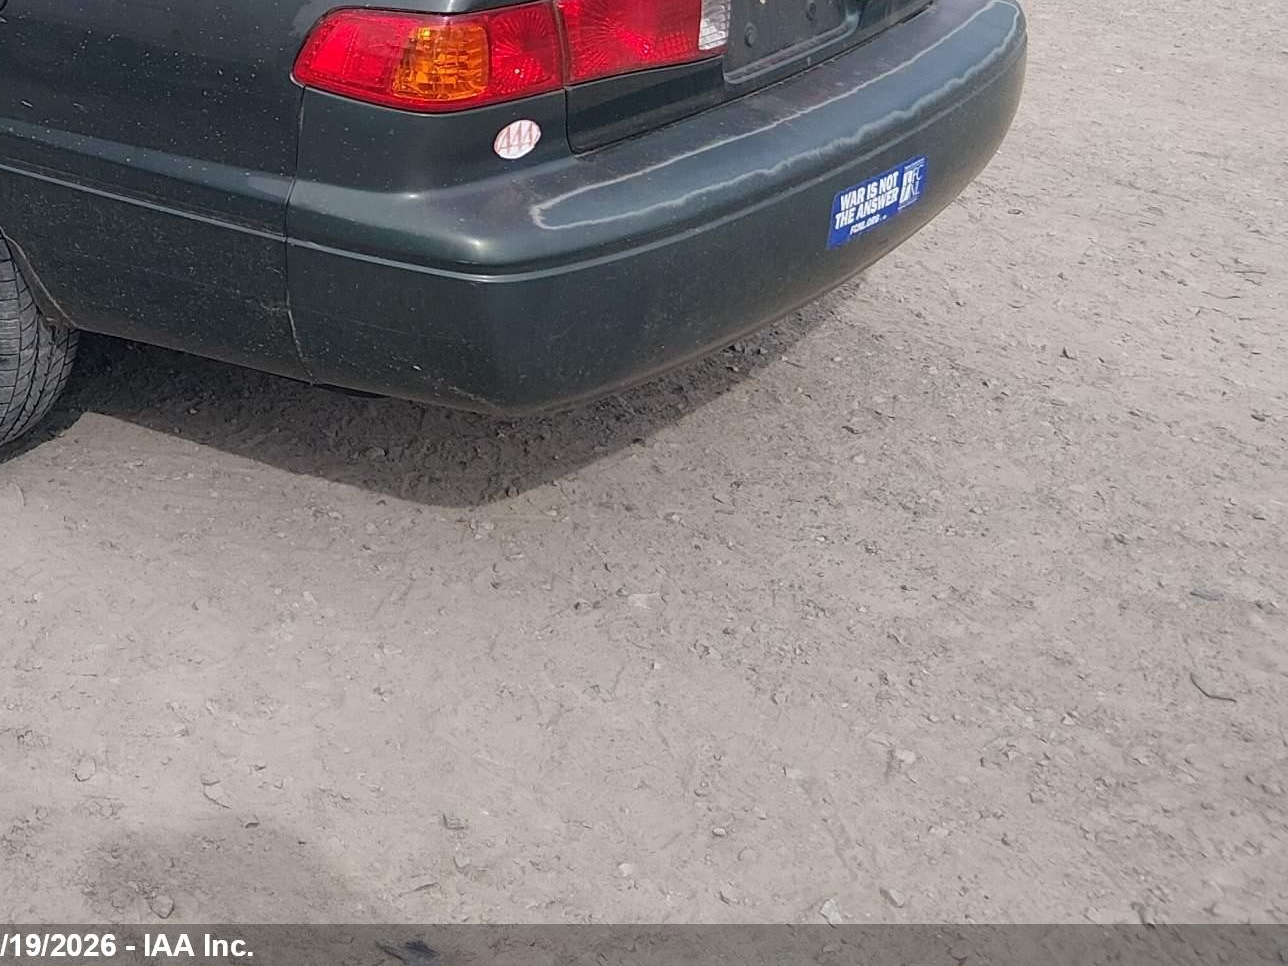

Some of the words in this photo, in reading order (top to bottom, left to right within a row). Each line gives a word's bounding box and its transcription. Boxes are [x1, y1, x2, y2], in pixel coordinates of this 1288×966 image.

[835, 207, 856, 229] THE
[856, 187, 899, 221] ANSWER
[840, 187, 865, 211] WAR
[866, 181, 879, 201] IS
[879, 171, 899, 195] NOT
